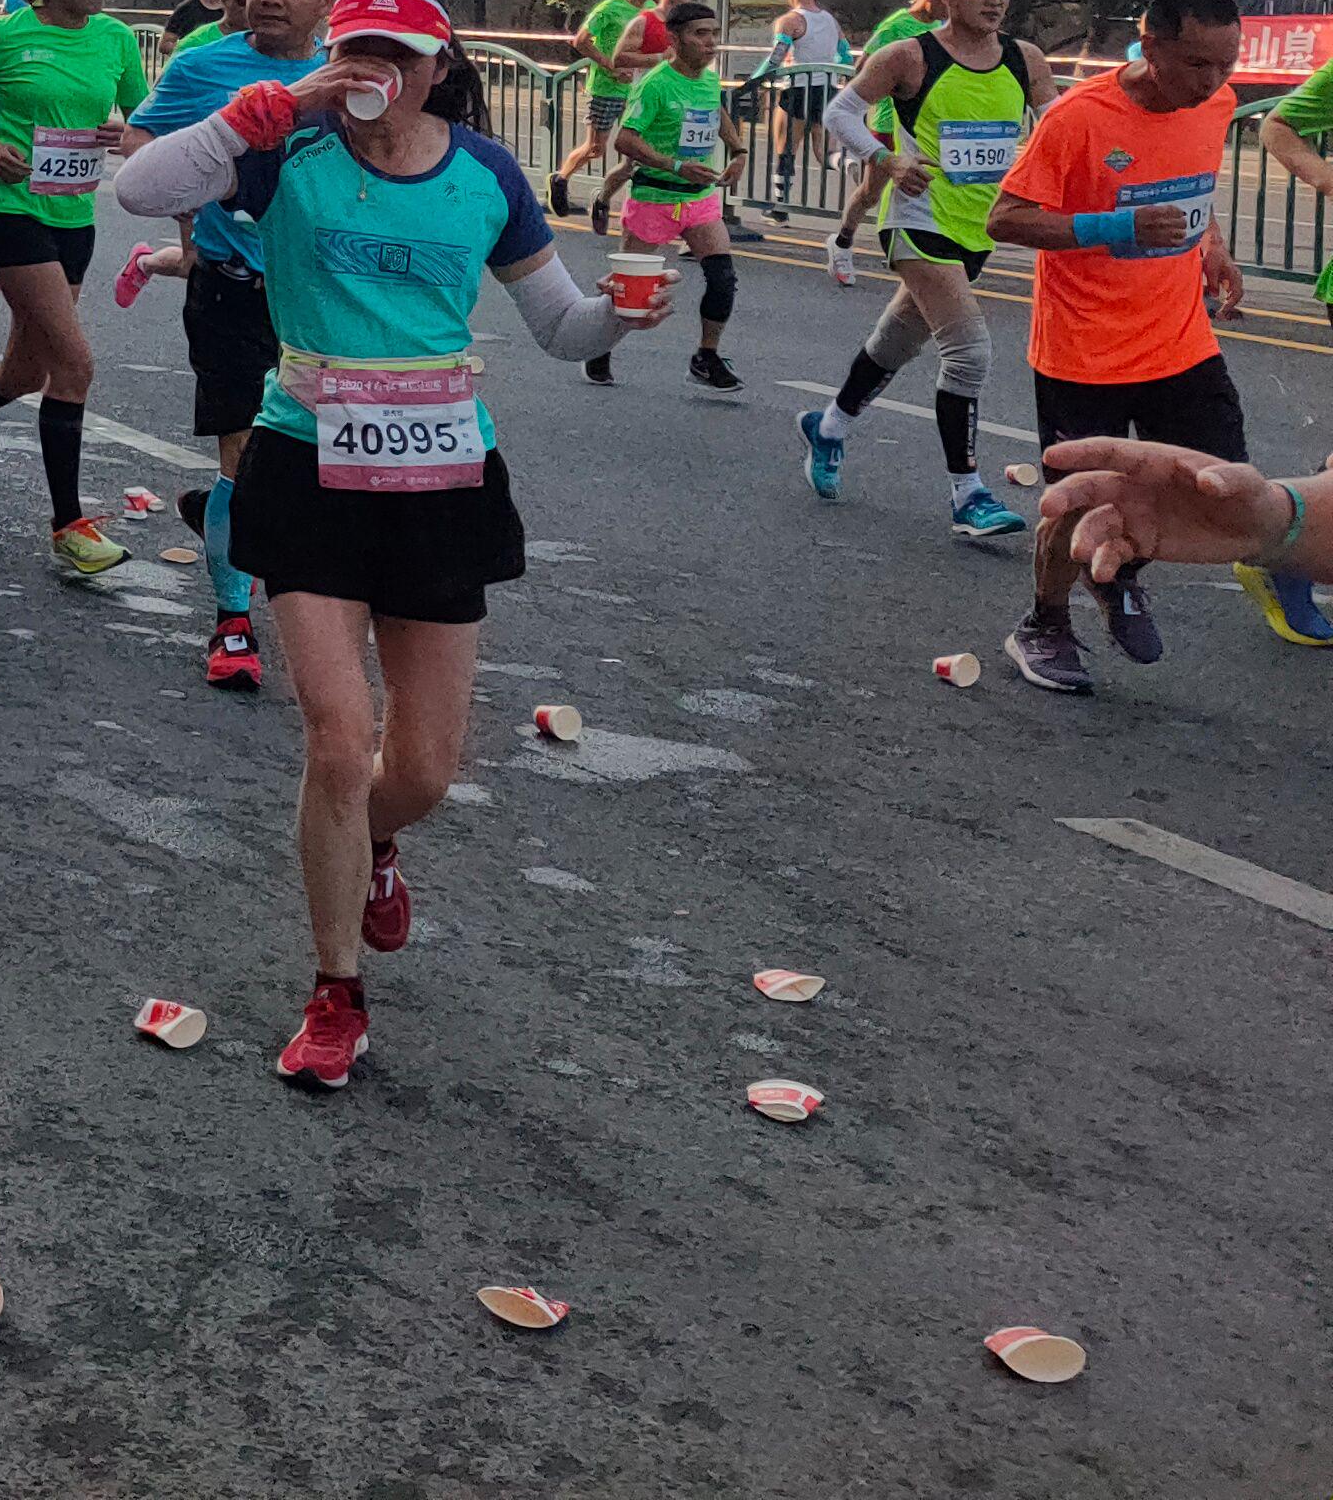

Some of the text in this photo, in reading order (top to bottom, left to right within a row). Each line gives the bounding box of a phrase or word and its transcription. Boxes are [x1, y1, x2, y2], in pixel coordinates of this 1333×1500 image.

[1239, 25, 1316, 69] 山泉
[39, 157, 99, 178] 42597
[949, 148, 1005, 167] 31590
[333, 422, 458, 456] 40995
